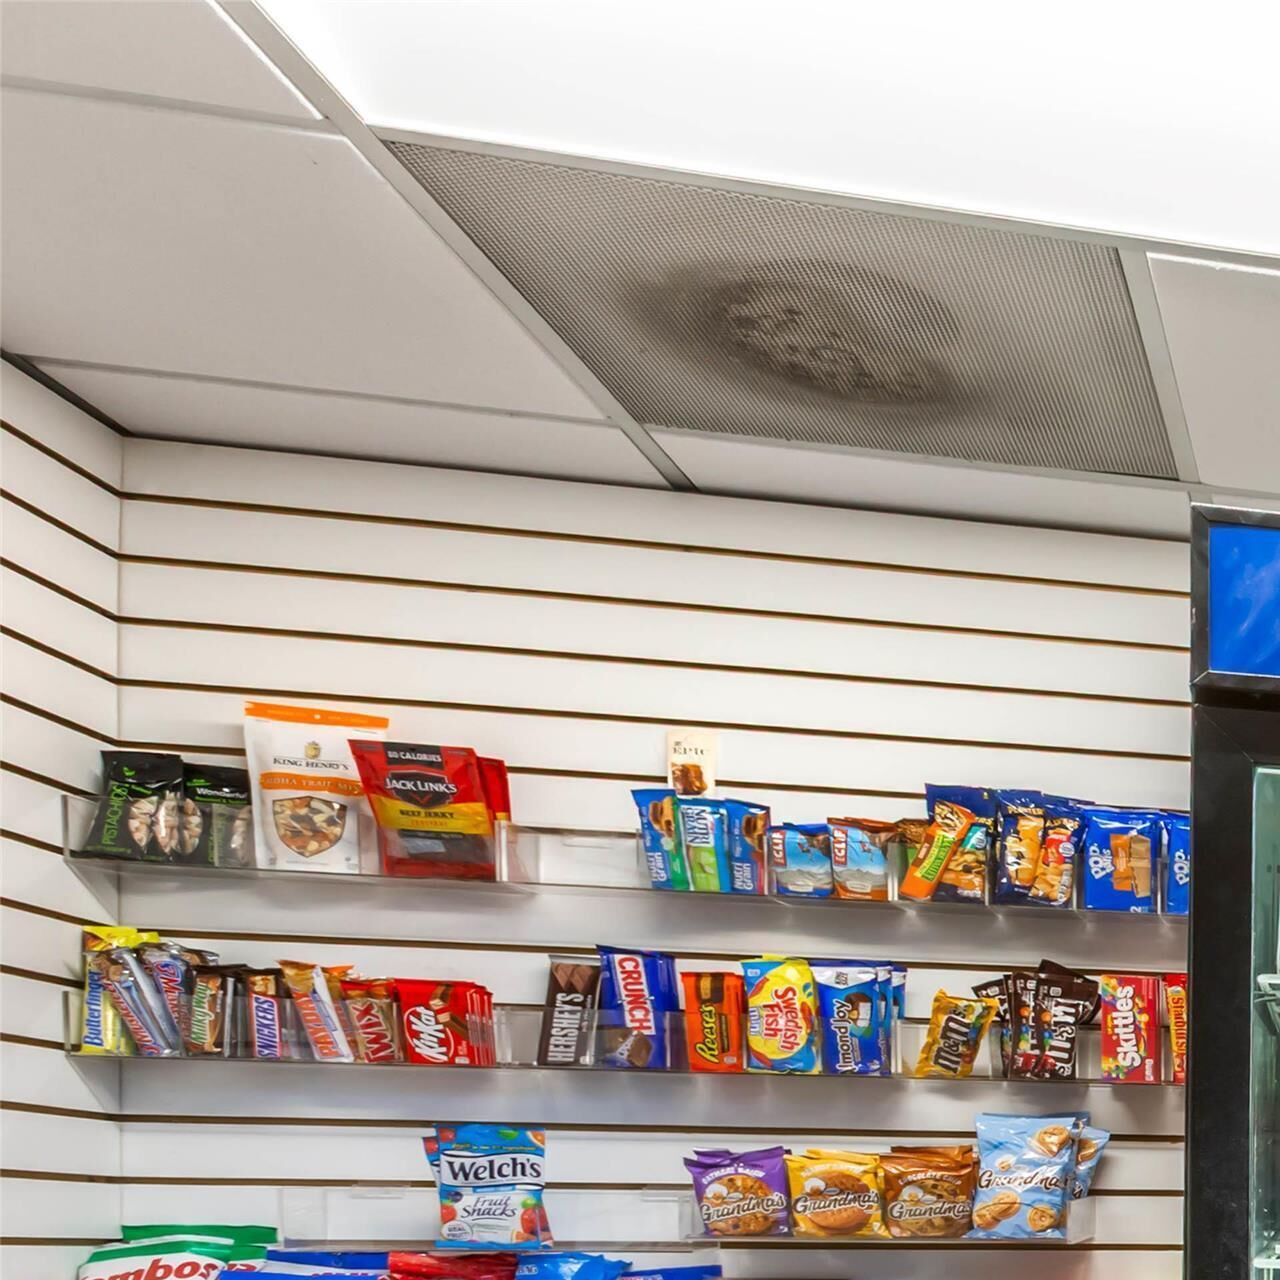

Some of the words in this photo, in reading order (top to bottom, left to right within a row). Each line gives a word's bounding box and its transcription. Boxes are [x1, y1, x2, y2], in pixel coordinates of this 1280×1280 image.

[272, 757, 303, 768] KING
[305, 761, 349, 772] HENRY'S
[400, 751, 442, 763] CALORIES
[196, 787, 248, 799] Wonderful
[385, 777, 417, 791] JACK
[84, 969, 104, 1047] Butterfinger
[617, 955, 653, 1035] CRUNCH
[253, 996, 280, 1059] SNICKERS
[352, 1002, 394, 1063] TWIX
[548, 993, 583, 1064] HERSHEY'S
[696, 1003, 720, 1063] Reese's
[762, 1002, 784, 1038] Fish
[775, 986, 800, 1051] Swedish
[1111, 985, 1142, 1069] Skittles
[447, 1157, 542, 1182] Welch's
[461, 1205, 517, 1219] Snacks
[474, 1195, 511, 1208] Fruit
[700, 1192, 786, 1222] Grandma's
[793, 1190, 880, 1214] Grandma's
[889, 1201, 972, 1222] Grandma's
